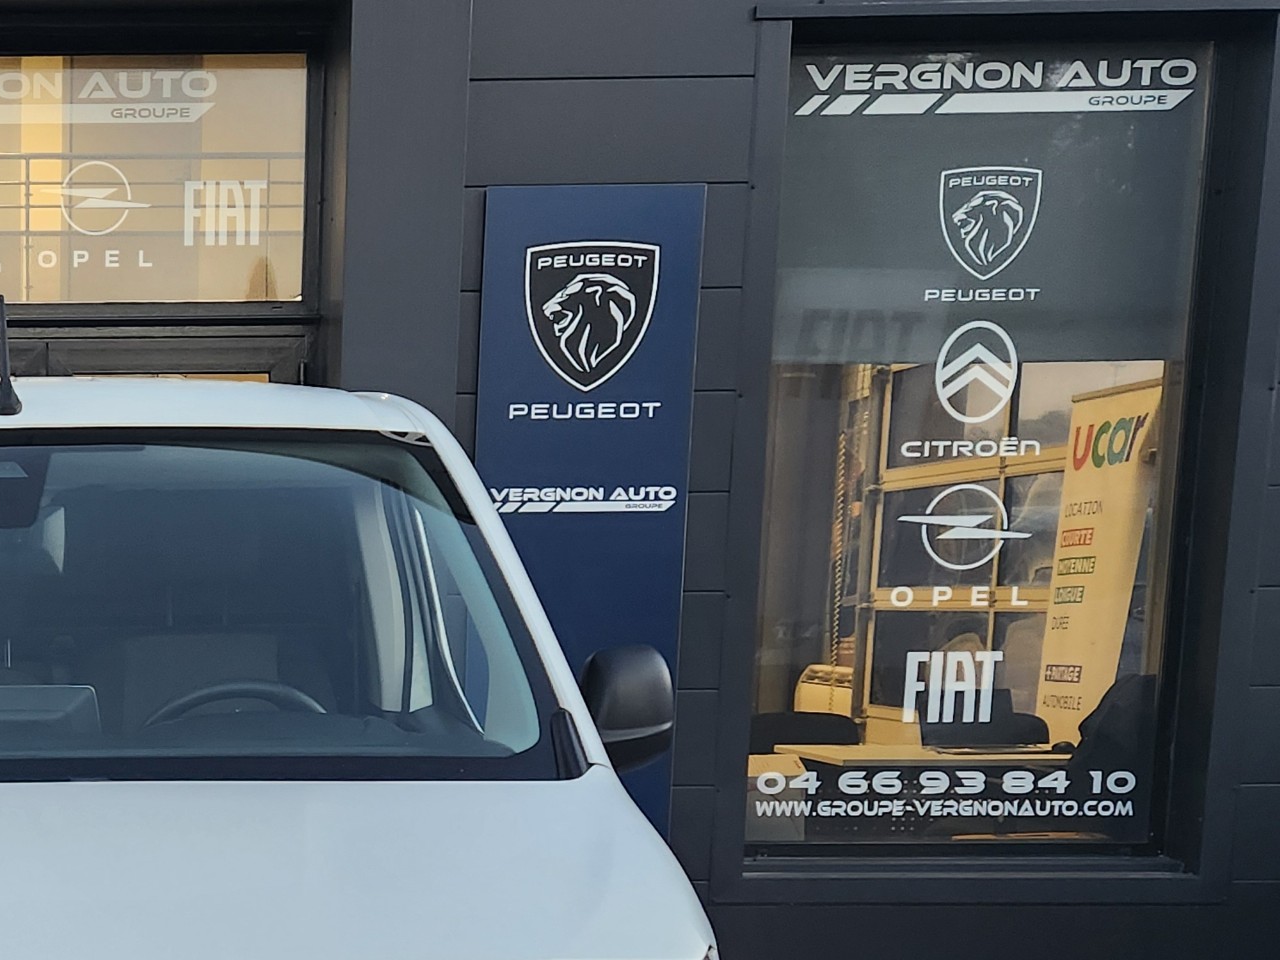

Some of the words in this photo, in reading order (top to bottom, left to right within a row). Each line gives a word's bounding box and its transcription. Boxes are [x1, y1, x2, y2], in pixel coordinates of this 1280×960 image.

[78, 70, 218, 99] AUTO
[806, 62, 1043, 90] VERGNON
[1058, 60, 1198, 88] AUTO
[1088, 94, 1168, 106] GROUPE
[111, 107, 191, 119] GROUPE
[948, 175, 1033, 188] PEUGEOT
[184, 180, 267, 246] FIAT
[38, 249, 153, 269] OPEL
[536, 254, 648, 270] PEUGEOT
[924, 287, 1041, 302] PEUGEOT
[508, 401, 662, 420] PEUGEOT
[490, 487, 605, 502] VERGNON
[609, 486, 678, 501] AUTO
[890, 586, 1029, 607] OPEL
[902, 651, 1004, 723] FIAT
[756, 771, 822, 795] 04
[838, 771, 903, 795] 66
[919, 771, 987, 795] 93
[1002, 770, 1071, 794] 84
[1088, 770, 1137, 794] 10
[755, 800, 1134, 817] WWW.GROUPE-VERGNONAUTO.COM
